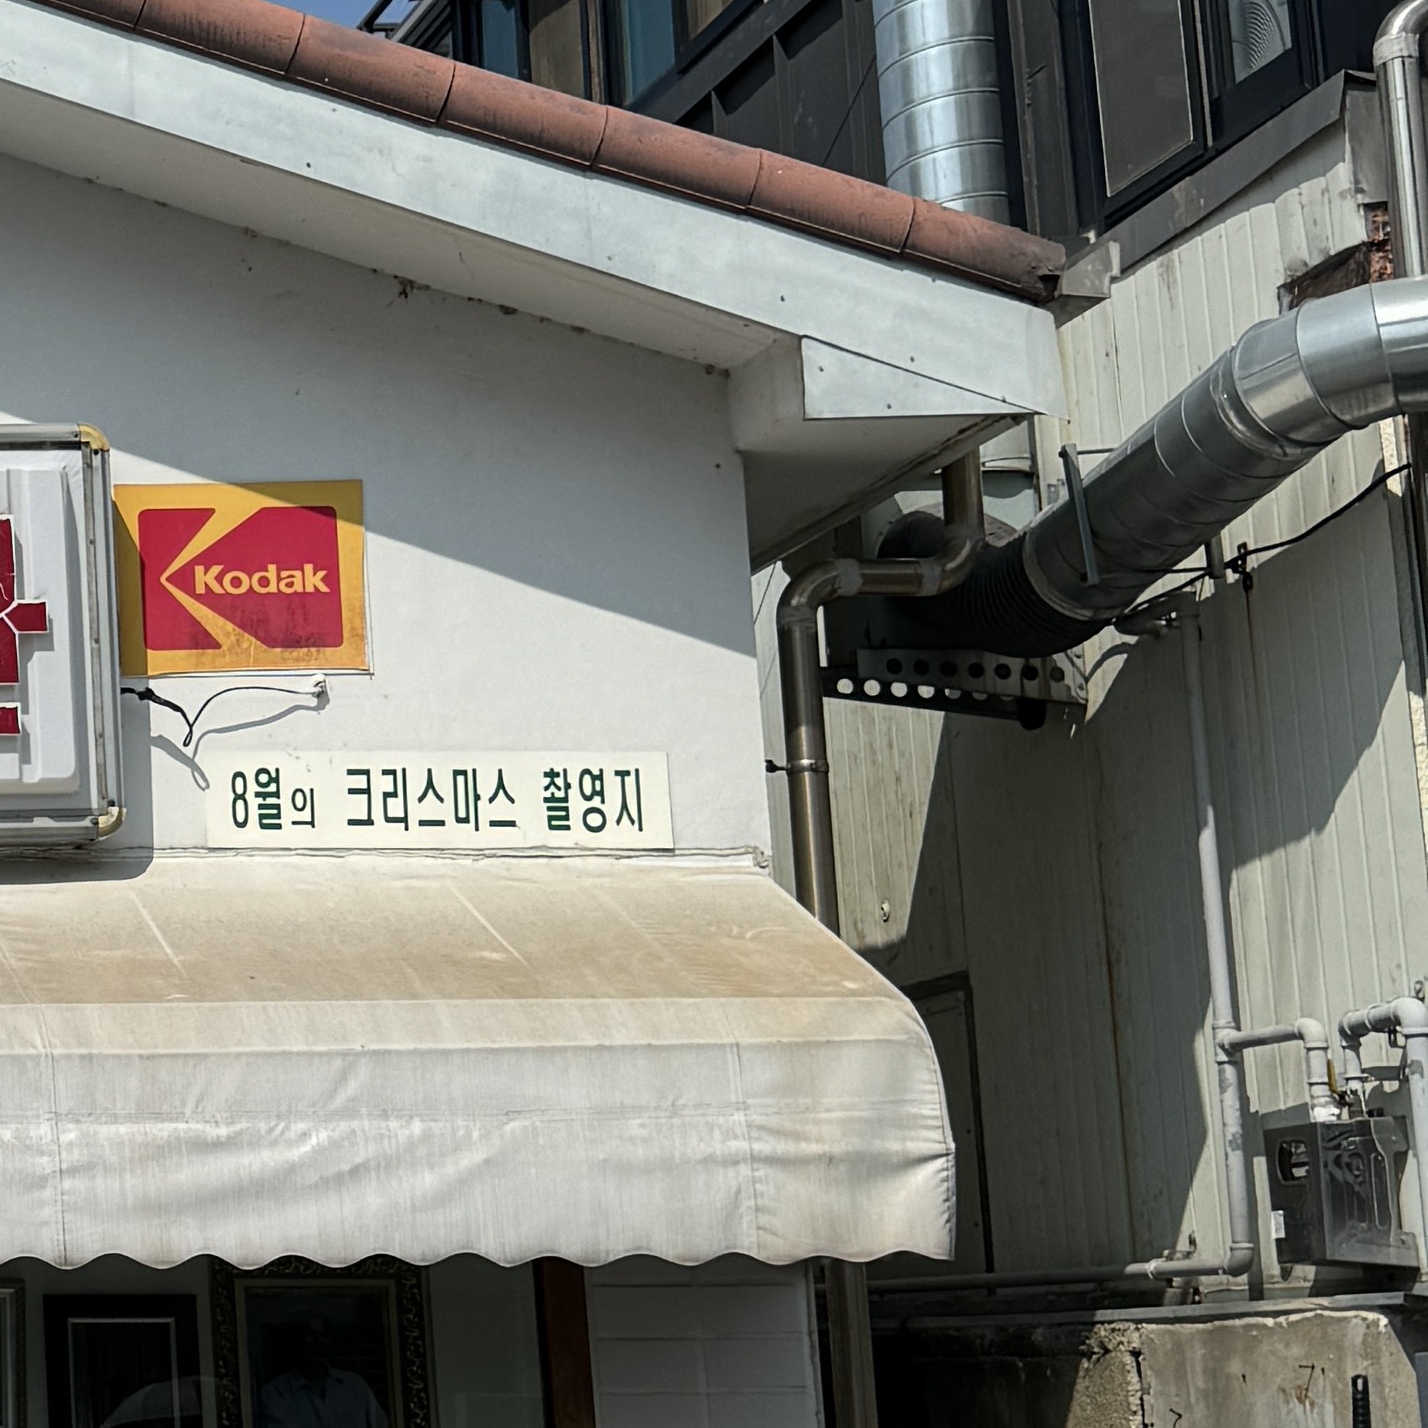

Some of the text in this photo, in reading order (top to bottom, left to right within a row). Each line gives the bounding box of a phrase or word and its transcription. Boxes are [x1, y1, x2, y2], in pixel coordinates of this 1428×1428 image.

[194, 563, 331, 595] Kodak
[231, 766, 644, 832] 8월의 크리스마스 촬영지
